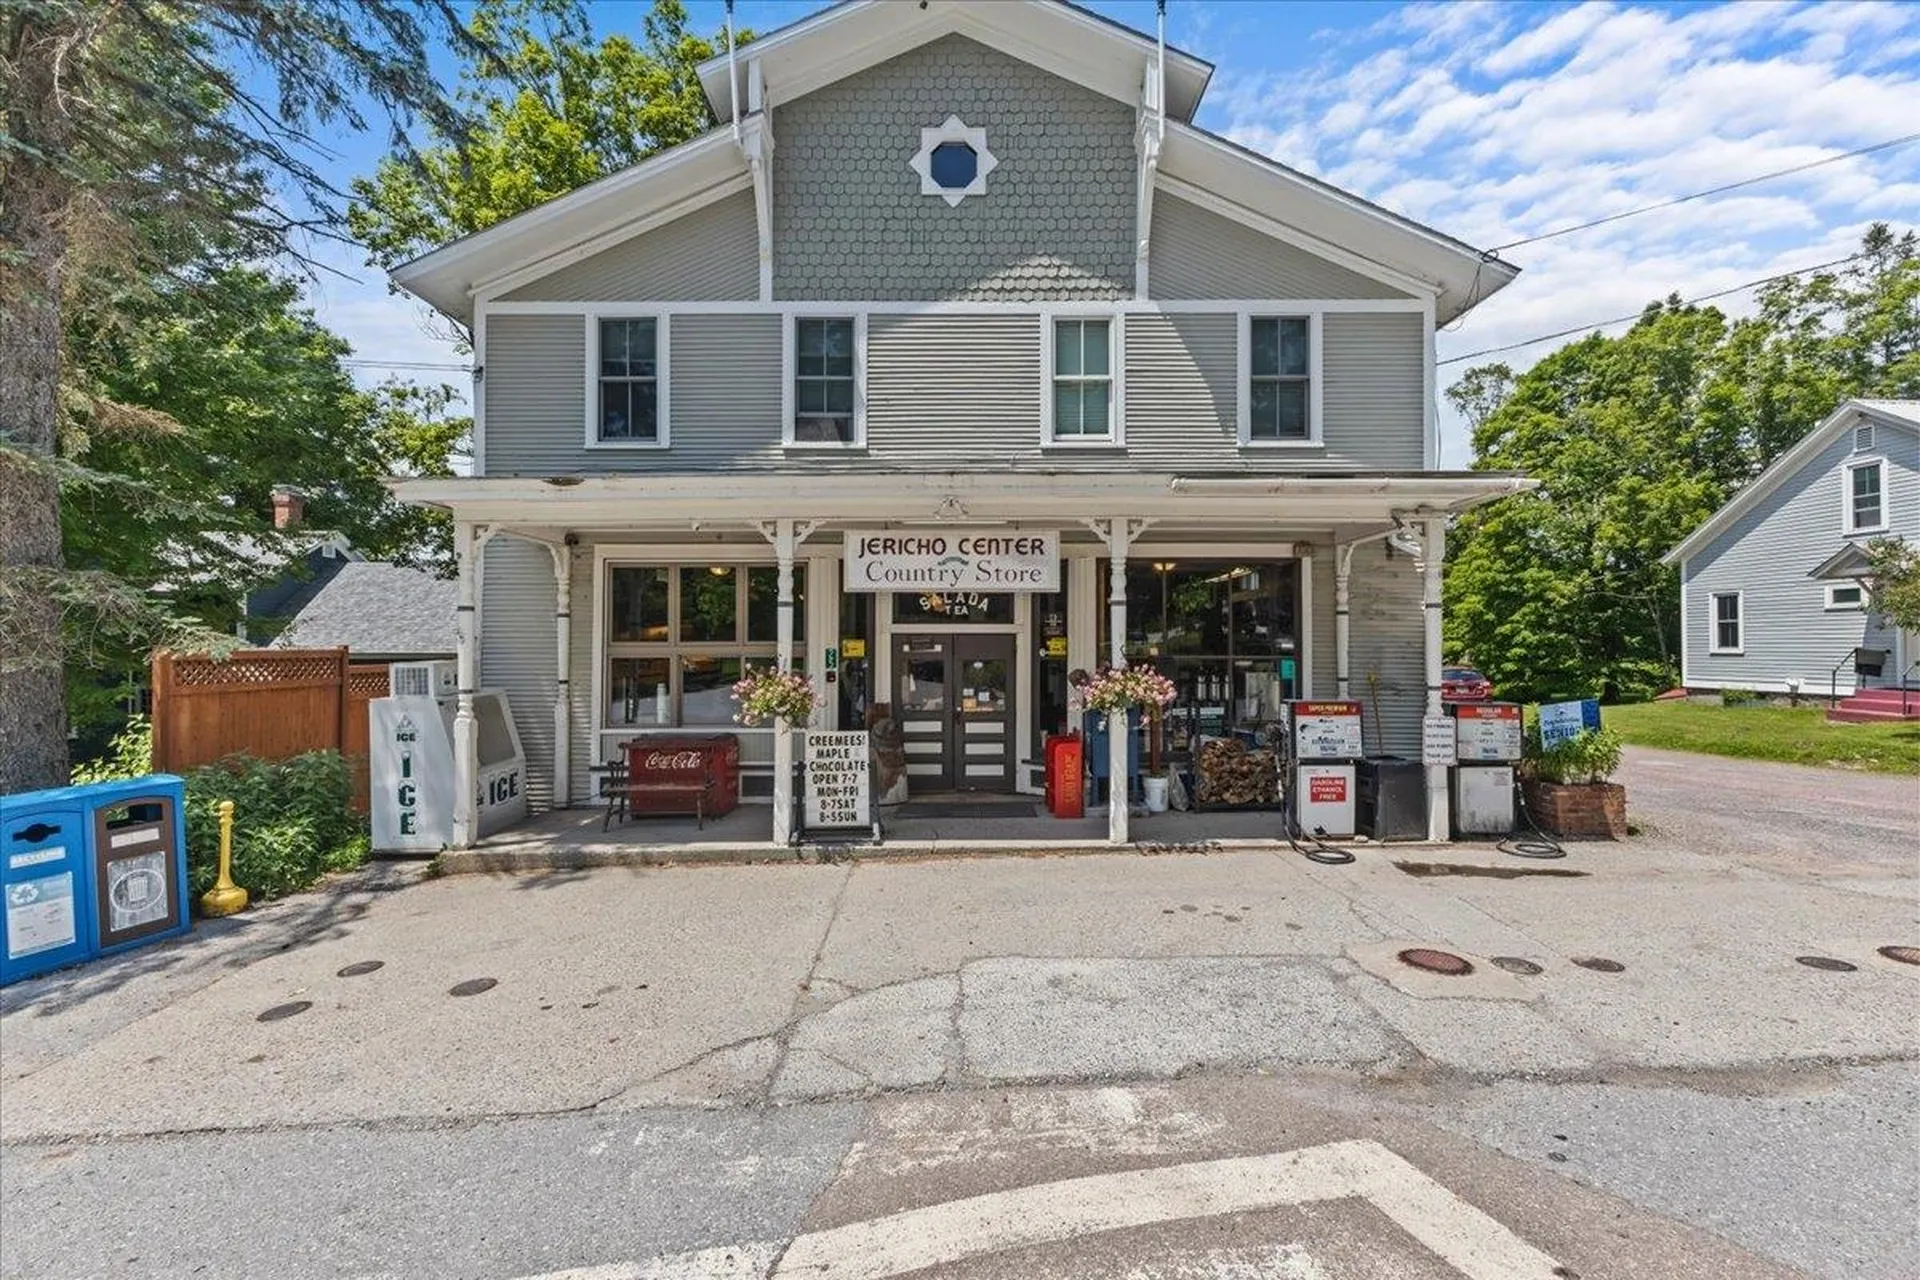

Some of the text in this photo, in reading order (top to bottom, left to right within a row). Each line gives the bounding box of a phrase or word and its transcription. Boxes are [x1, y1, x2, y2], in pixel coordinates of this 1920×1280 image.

[858, 537, 1045, 559] JERICHO CENTER
[866, 560, 1042, 587] Country Store
[946, 605, 968, 615] TEA
[396, 733, 416, 742] ICE
[816, 748, 850, 759] MAPLE
[645, 750, 702, 770] Coca-Cola
[809, 761, 865, 772] CHOCOLATE
[812, 774, 858, 784] OPEN 7-7
[397, 751, 416, 836] ICE
[488, 771, 520, 806] ICE
[816, 786, 859, 797] MON-FRI
